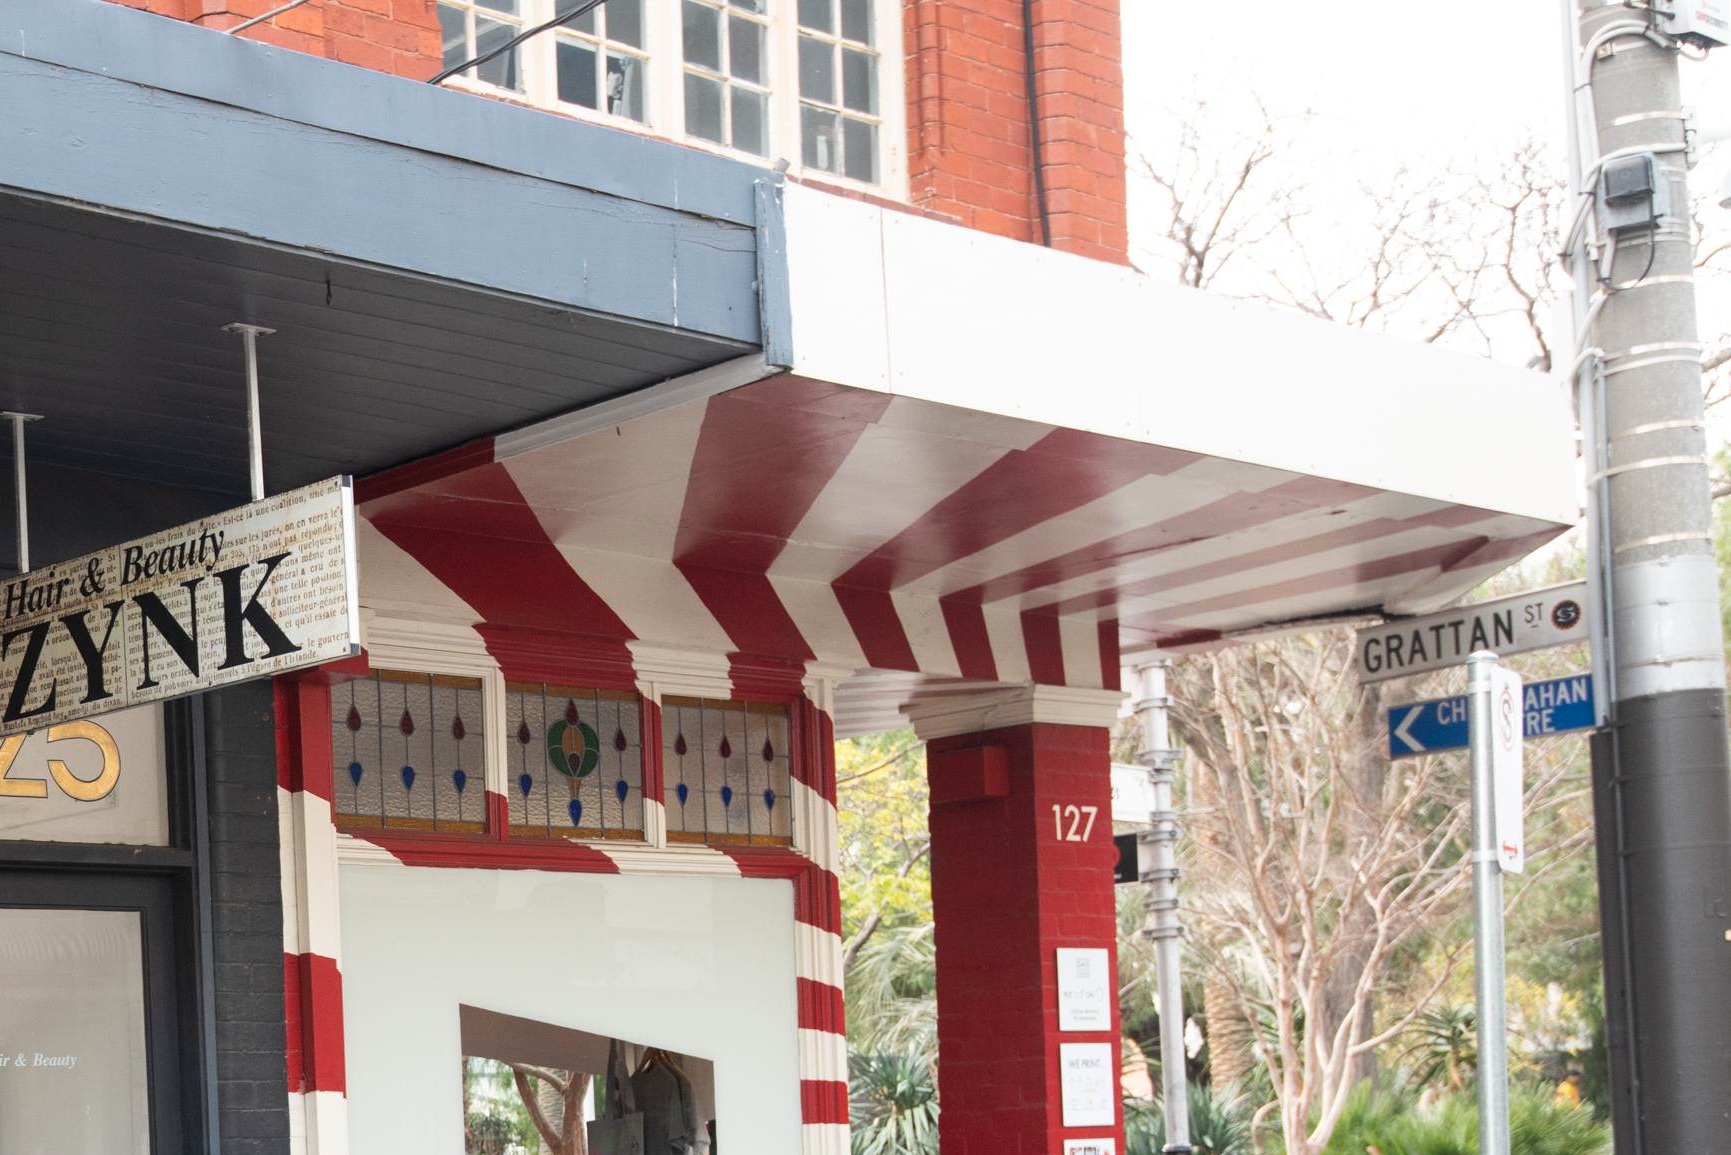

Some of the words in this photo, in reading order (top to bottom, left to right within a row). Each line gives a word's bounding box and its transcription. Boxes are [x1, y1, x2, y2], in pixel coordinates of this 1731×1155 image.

[3, 571, 69, 620] Hair
[79, 558, 106, 597] &
[120, 528, 224, 586] Beauty
[2, 552, 301, 722] ZYNK
[1363, 609, 1514, 674] GRATTAN
[1524, 602, 1543, 625] ST
[1524, 678, 1587, 709] AHAN
[1052, 804, 1098, 842] 127
[14, 1053, 27, 1068] &
[32, 1053, 77, 1069] Beauty
